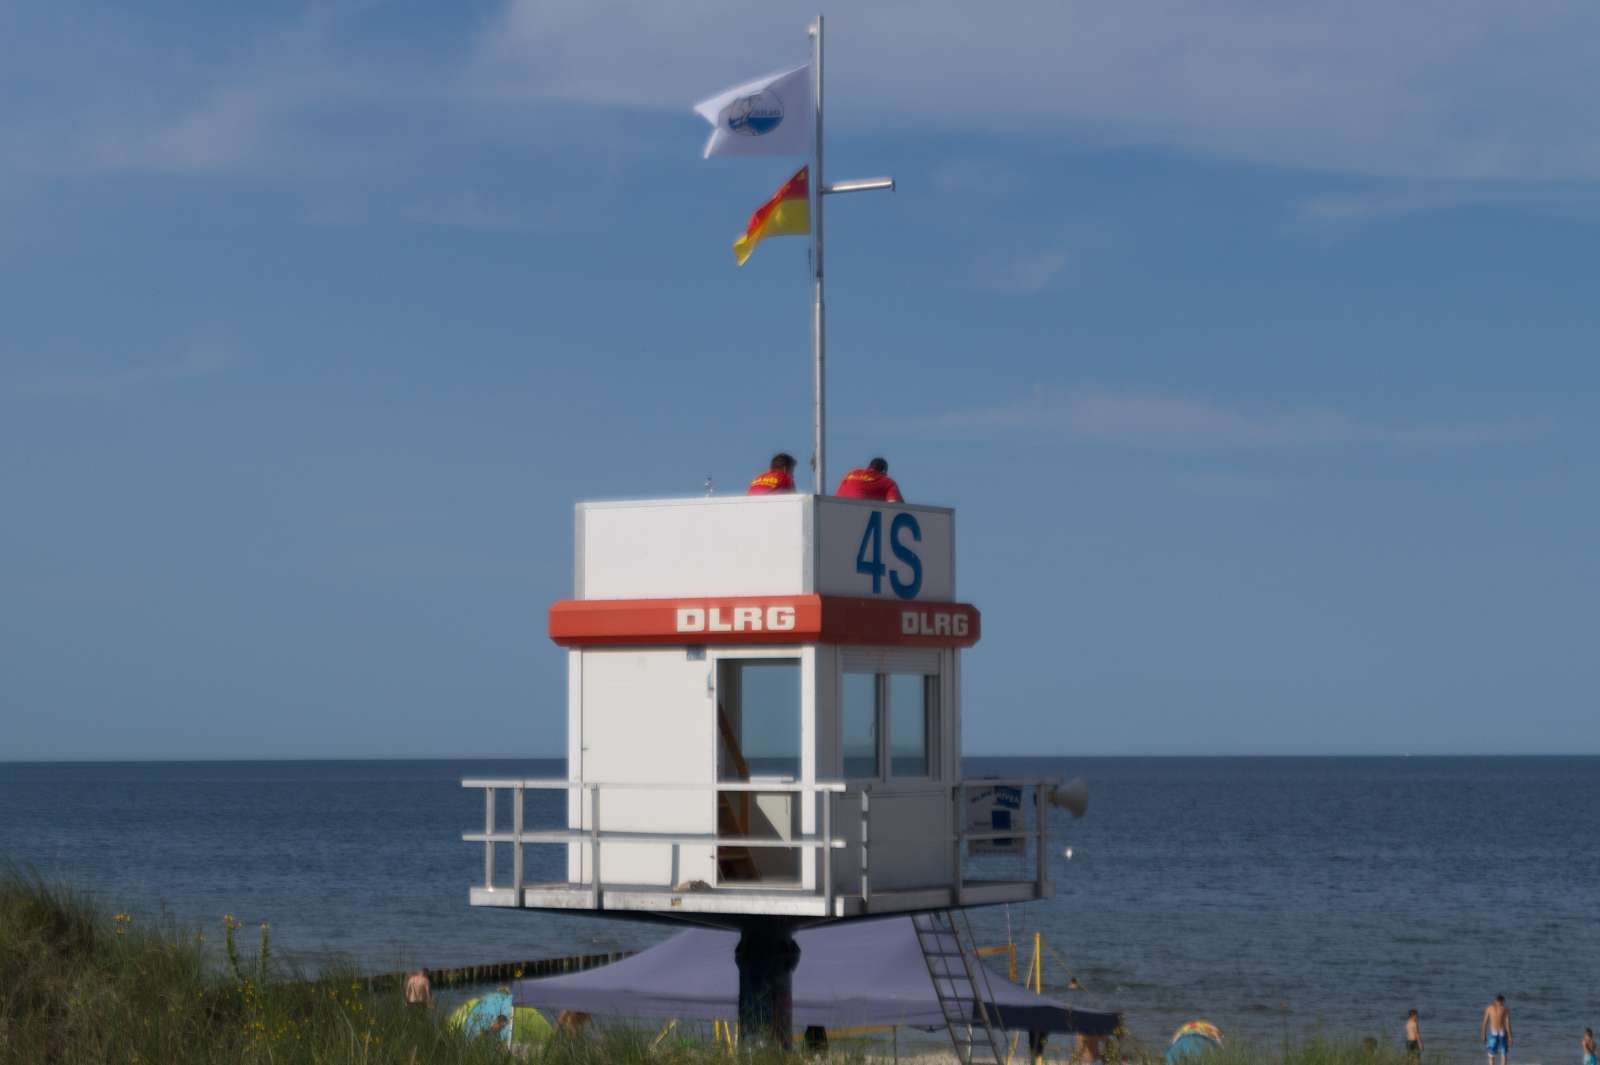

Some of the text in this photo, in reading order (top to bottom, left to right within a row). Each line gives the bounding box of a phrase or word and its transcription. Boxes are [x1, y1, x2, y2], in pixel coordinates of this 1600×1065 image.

[856, 511, 922, 600] 4S
[677, 606, 796, 632] DLRG
[901, 611, 969, 636] DLRG
